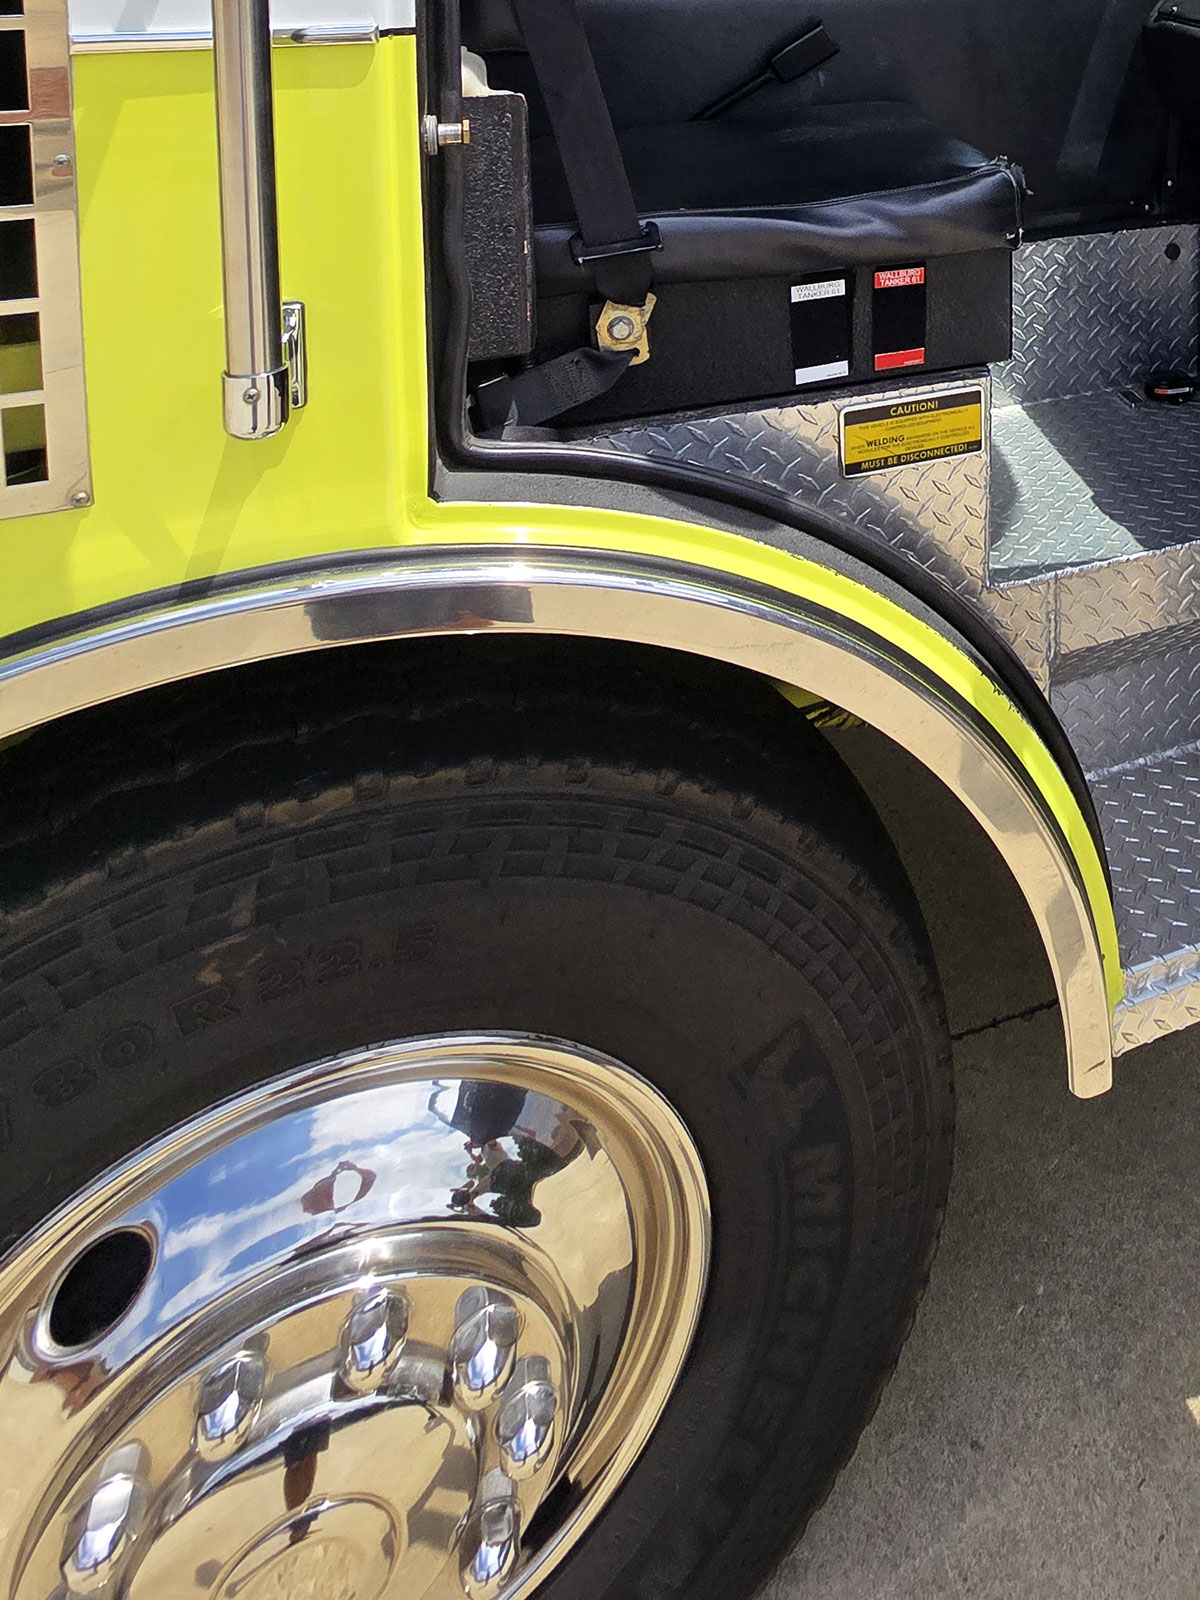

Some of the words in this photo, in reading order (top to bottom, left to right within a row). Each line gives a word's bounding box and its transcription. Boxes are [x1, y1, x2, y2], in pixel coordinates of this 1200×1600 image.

[879, 269, 921, 279] WALLBURG
[880, 277, 911, 286] TANKER
[796, 282, 841, 293] WALLBURG
[798, 290, 831, 299] TANKER
[890, 401, 938, 416] CAUTION!
[865, 433, 905, 448] WELDING
[861, 460, 885, 469] MUST
[888, 457, 898, 465] BE
[901, 444, 968, 463] DISCONNECTED!
